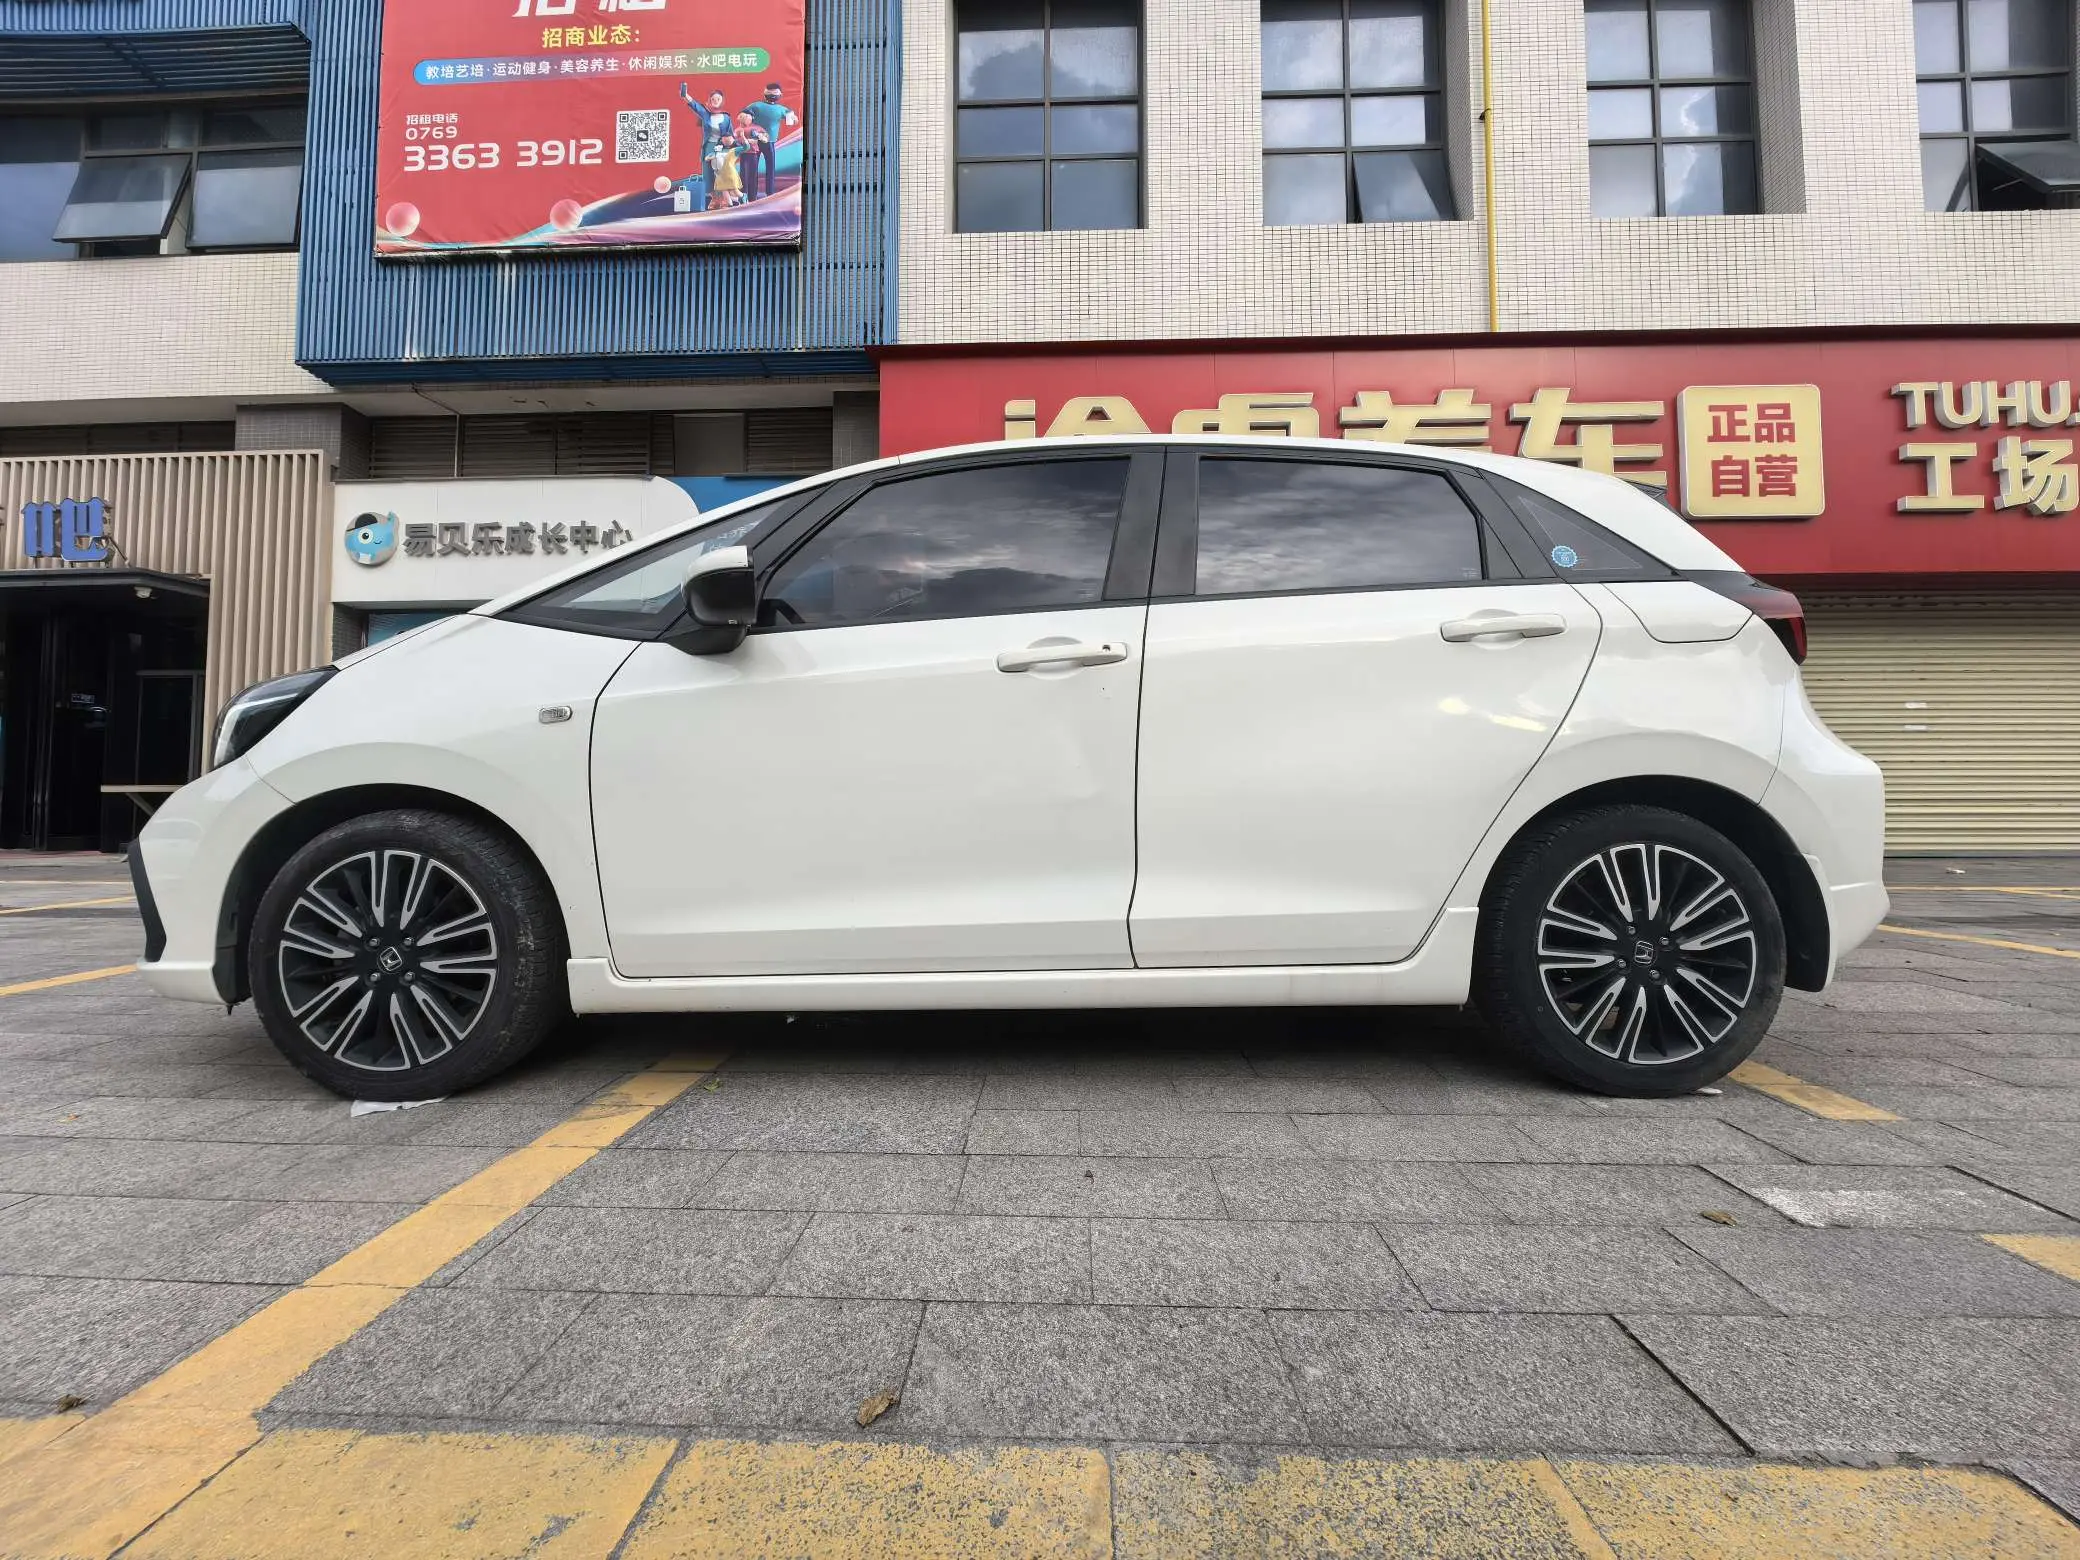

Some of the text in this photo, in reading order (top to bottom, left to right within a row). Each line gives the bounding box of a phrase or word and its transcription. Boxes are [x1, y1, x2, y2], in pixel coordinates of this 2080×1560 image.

[542, 23, 641, 49] 招商业态:
[405, 125, 458, 141] 0769
[406, 113, 459, 125] 招租电话
[403, 138, 604, 172] 3363 3912
[1706, 402, 1796, 444] 正品
[1711, 454, 1798, 498] 自营
[1897, 435, 2080, 516] 工场
[402, 519, 634, 557] 易贝乐成长中心
